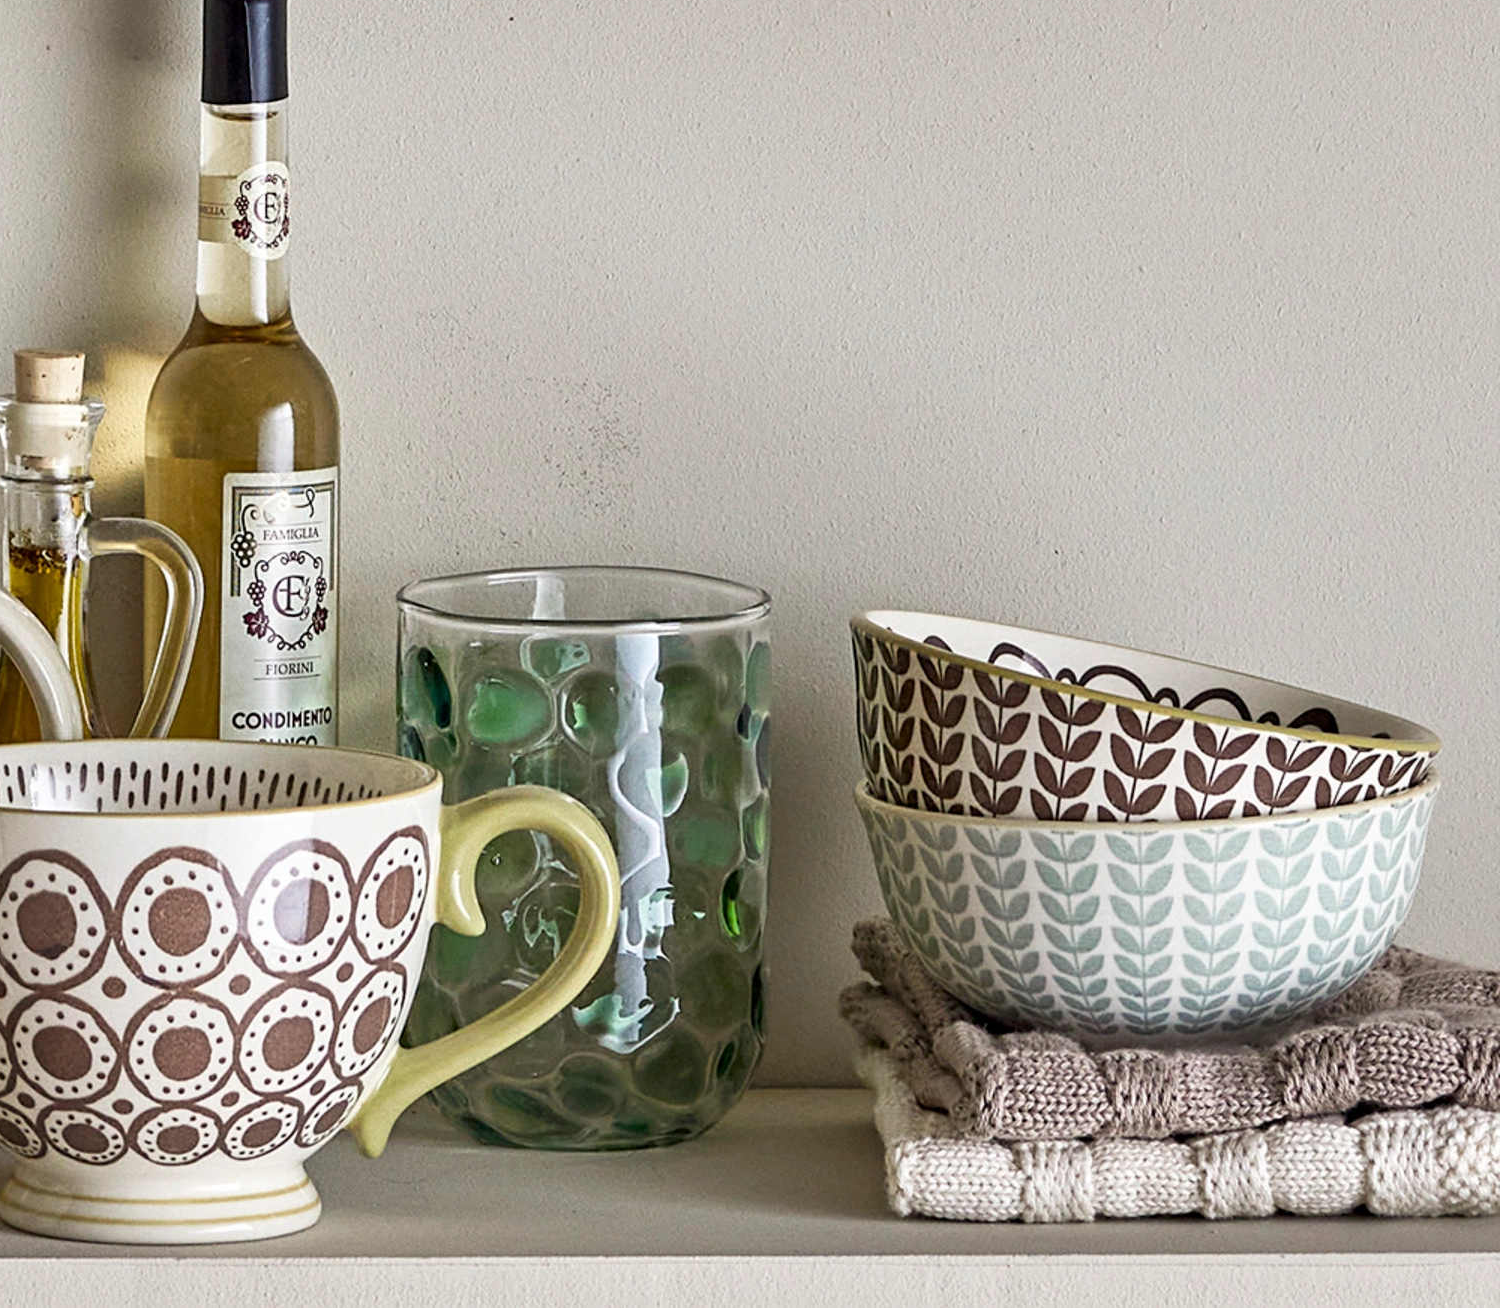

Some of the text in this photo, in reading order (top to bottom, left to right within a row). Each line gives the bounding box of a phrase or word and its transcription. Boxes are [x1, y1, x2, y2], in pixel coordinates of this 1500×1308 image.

[263, 527, 319, 541] FAMIGLIA
[265, 661, 314, 676] FIORINI
[232, 706, 332, 730] CONDIMENTO
